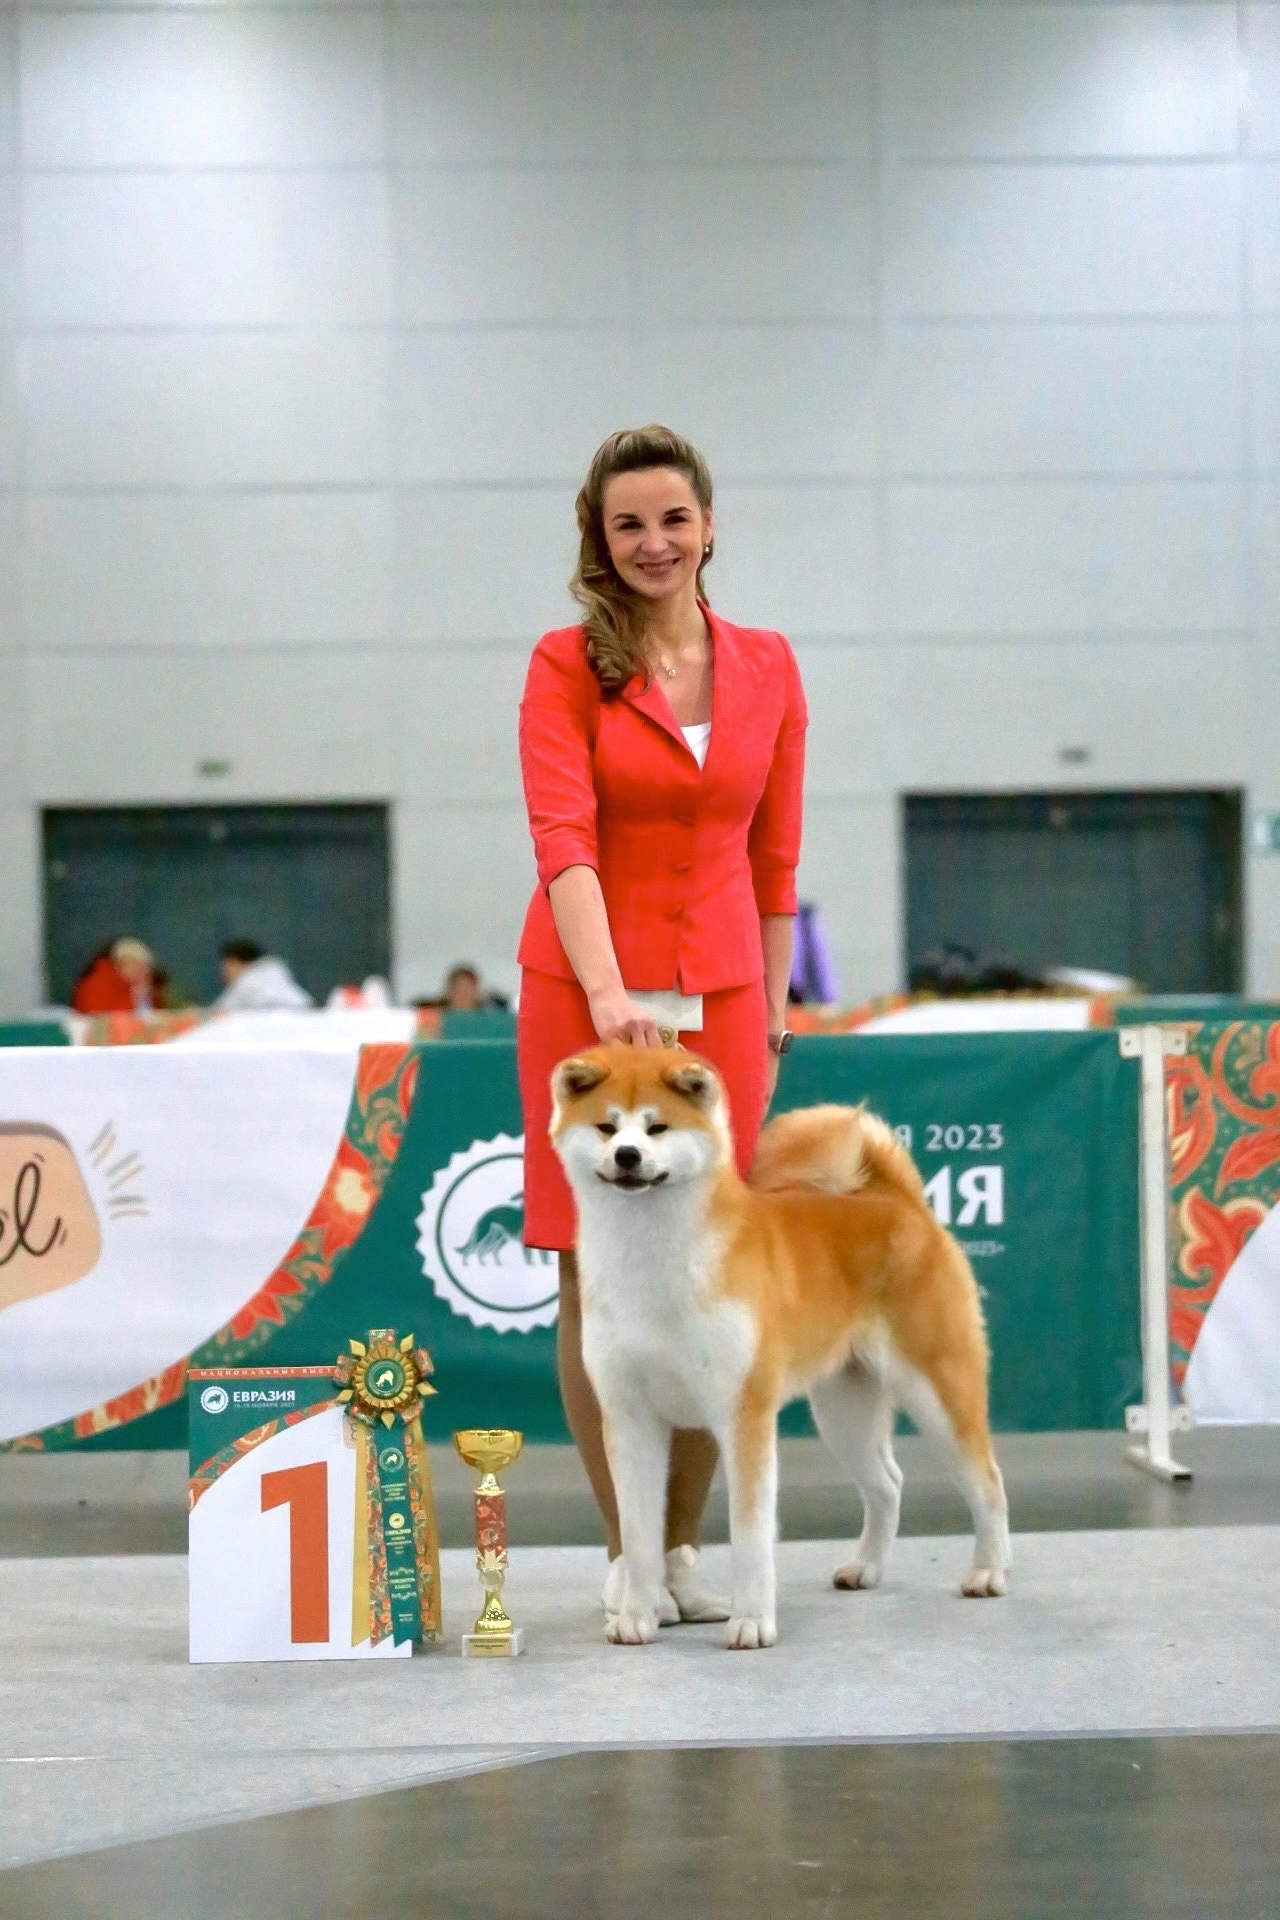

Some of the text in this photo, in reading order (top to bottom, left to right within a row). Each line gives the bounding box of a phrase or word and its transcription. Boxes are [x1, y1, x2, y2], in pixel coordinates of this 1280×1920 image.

[924, 1124, 1004, 1151] 2023
[233, 1390, 296, 1402] ЕВРАЗИЯ
[261, 1460, 330, 1644] 1
